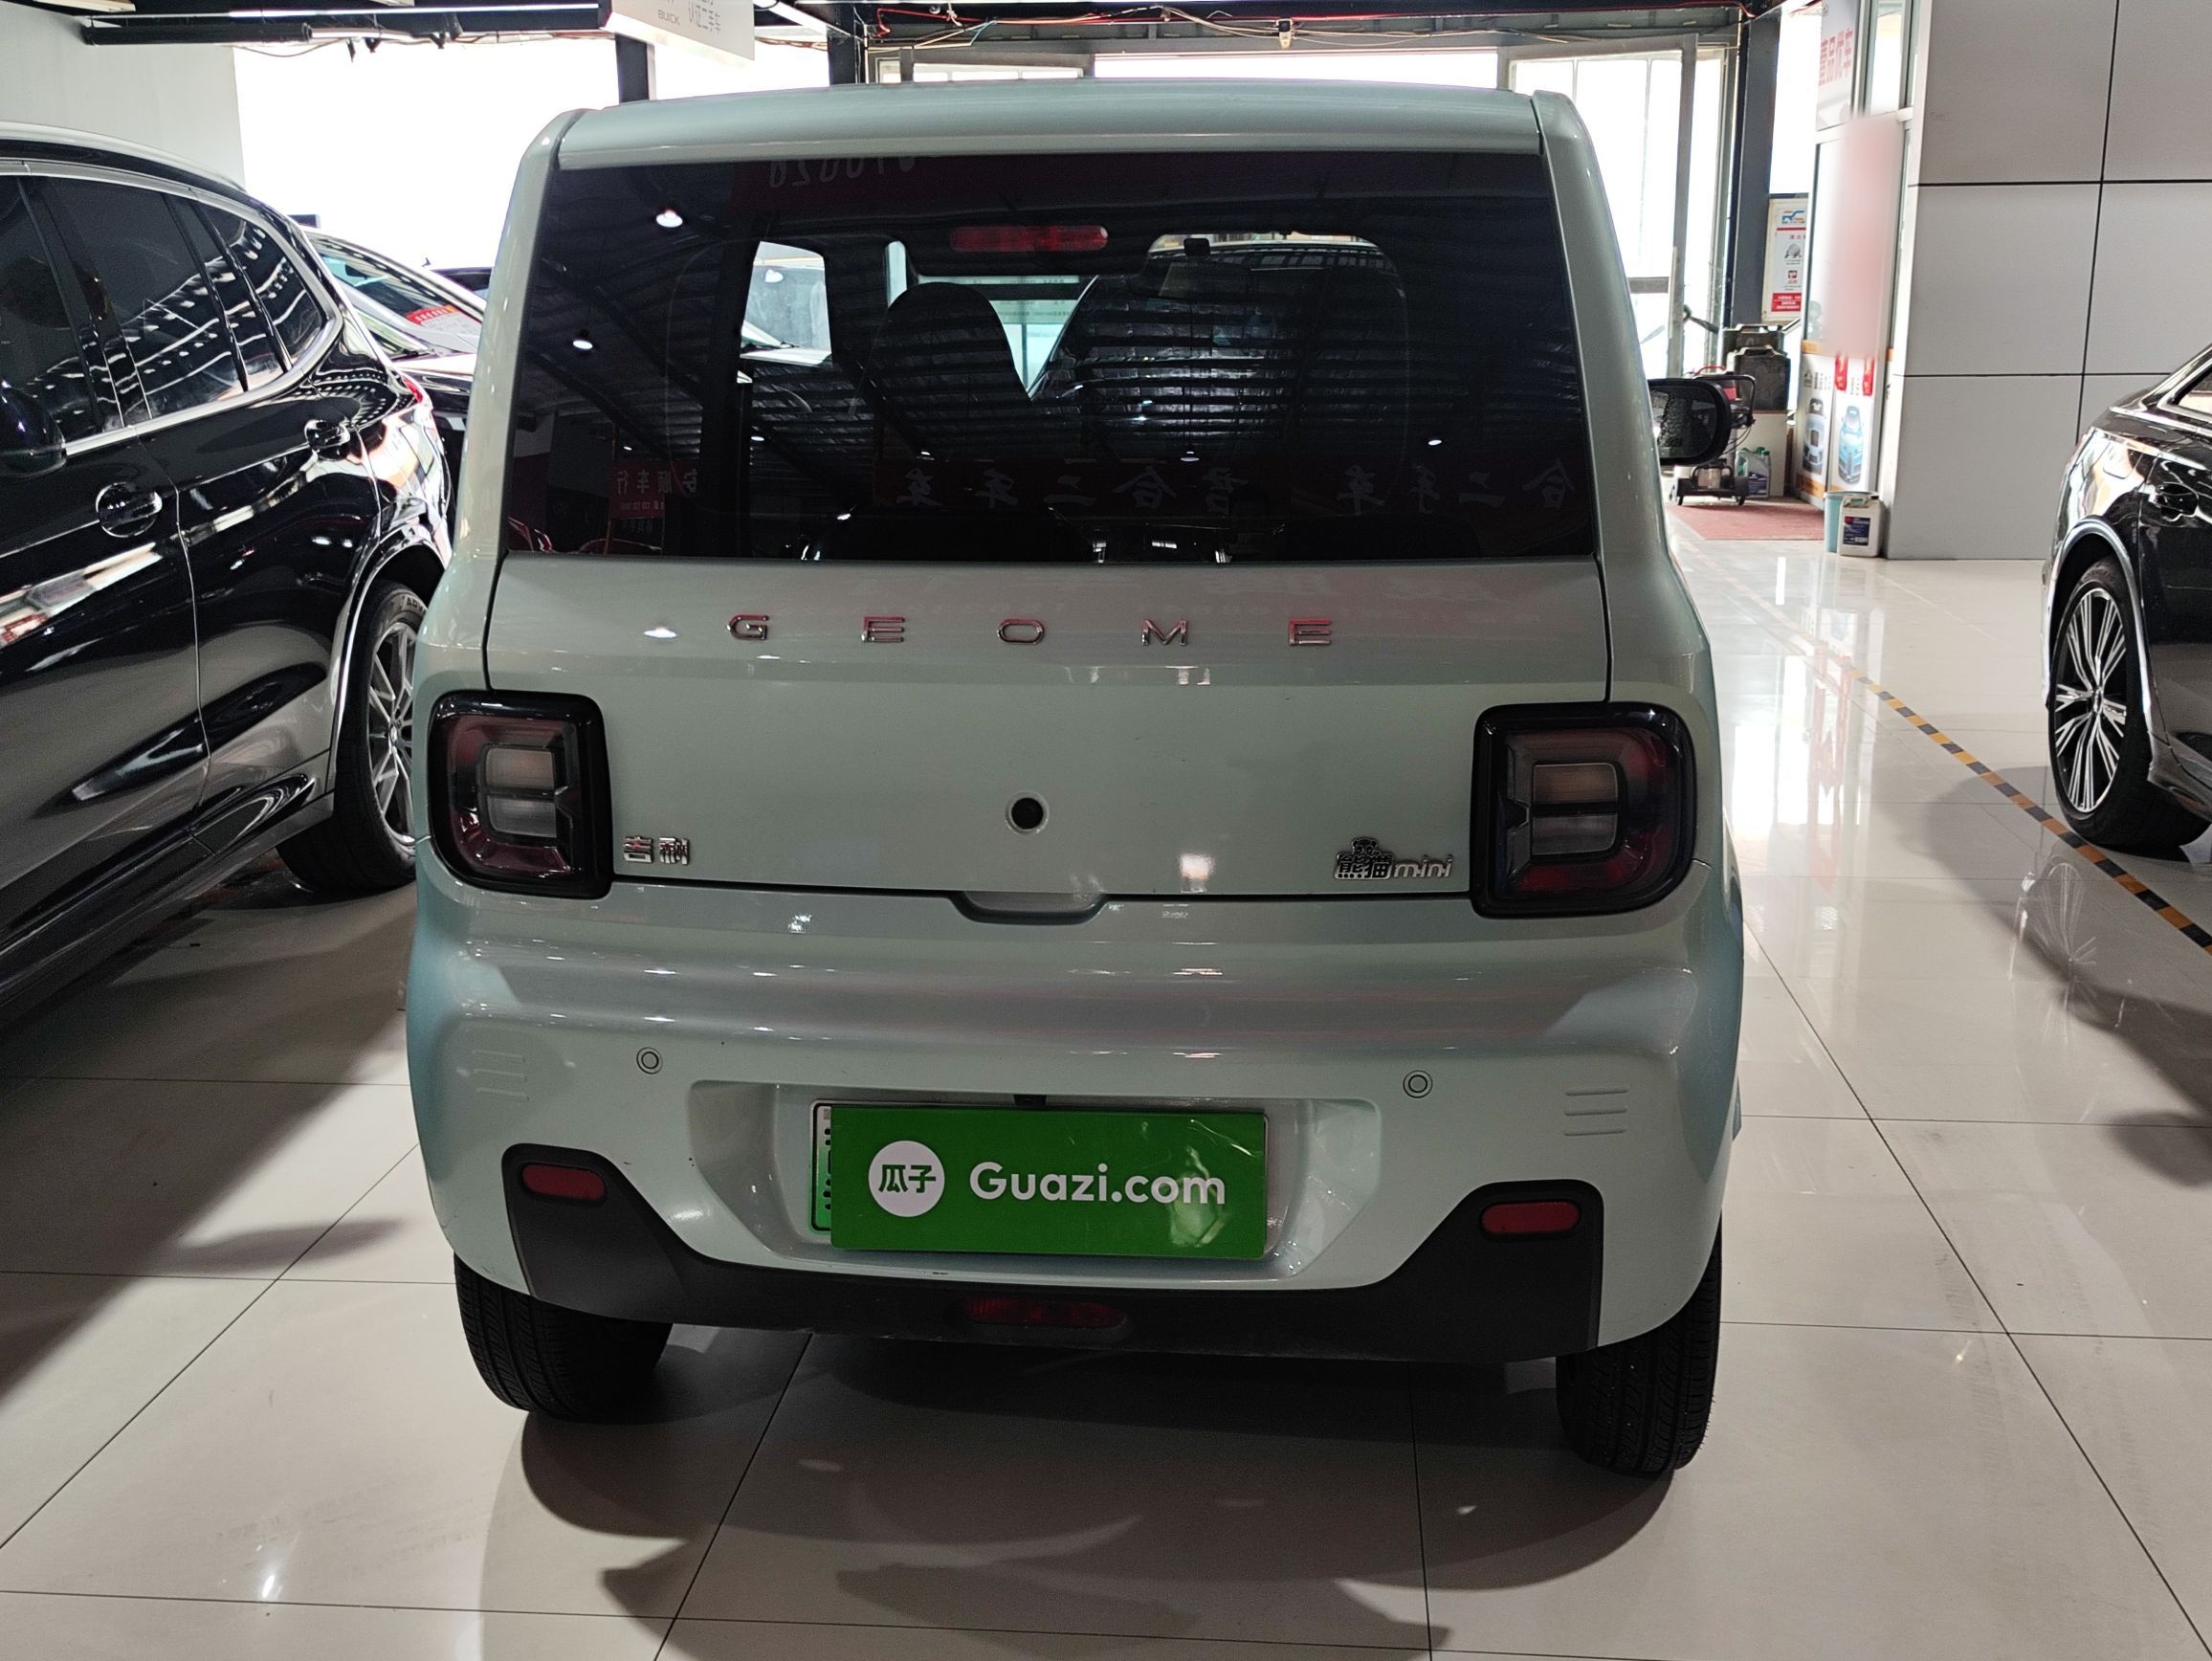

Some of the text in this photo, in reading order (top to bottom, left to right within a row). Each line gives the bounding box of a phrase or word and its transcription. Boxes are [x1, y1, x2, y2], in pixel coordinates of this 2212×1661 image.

[658, 9, 680, 25] BUICK
[726, 613, 1333, 647] GEOME
[623, 835, 689, 864] 吉利
[1393, 854, 1454, 878] mini
[878, 1163, 937, 1194] 瓜子
[969, 1161, 1226, 1206] Guazi.com
